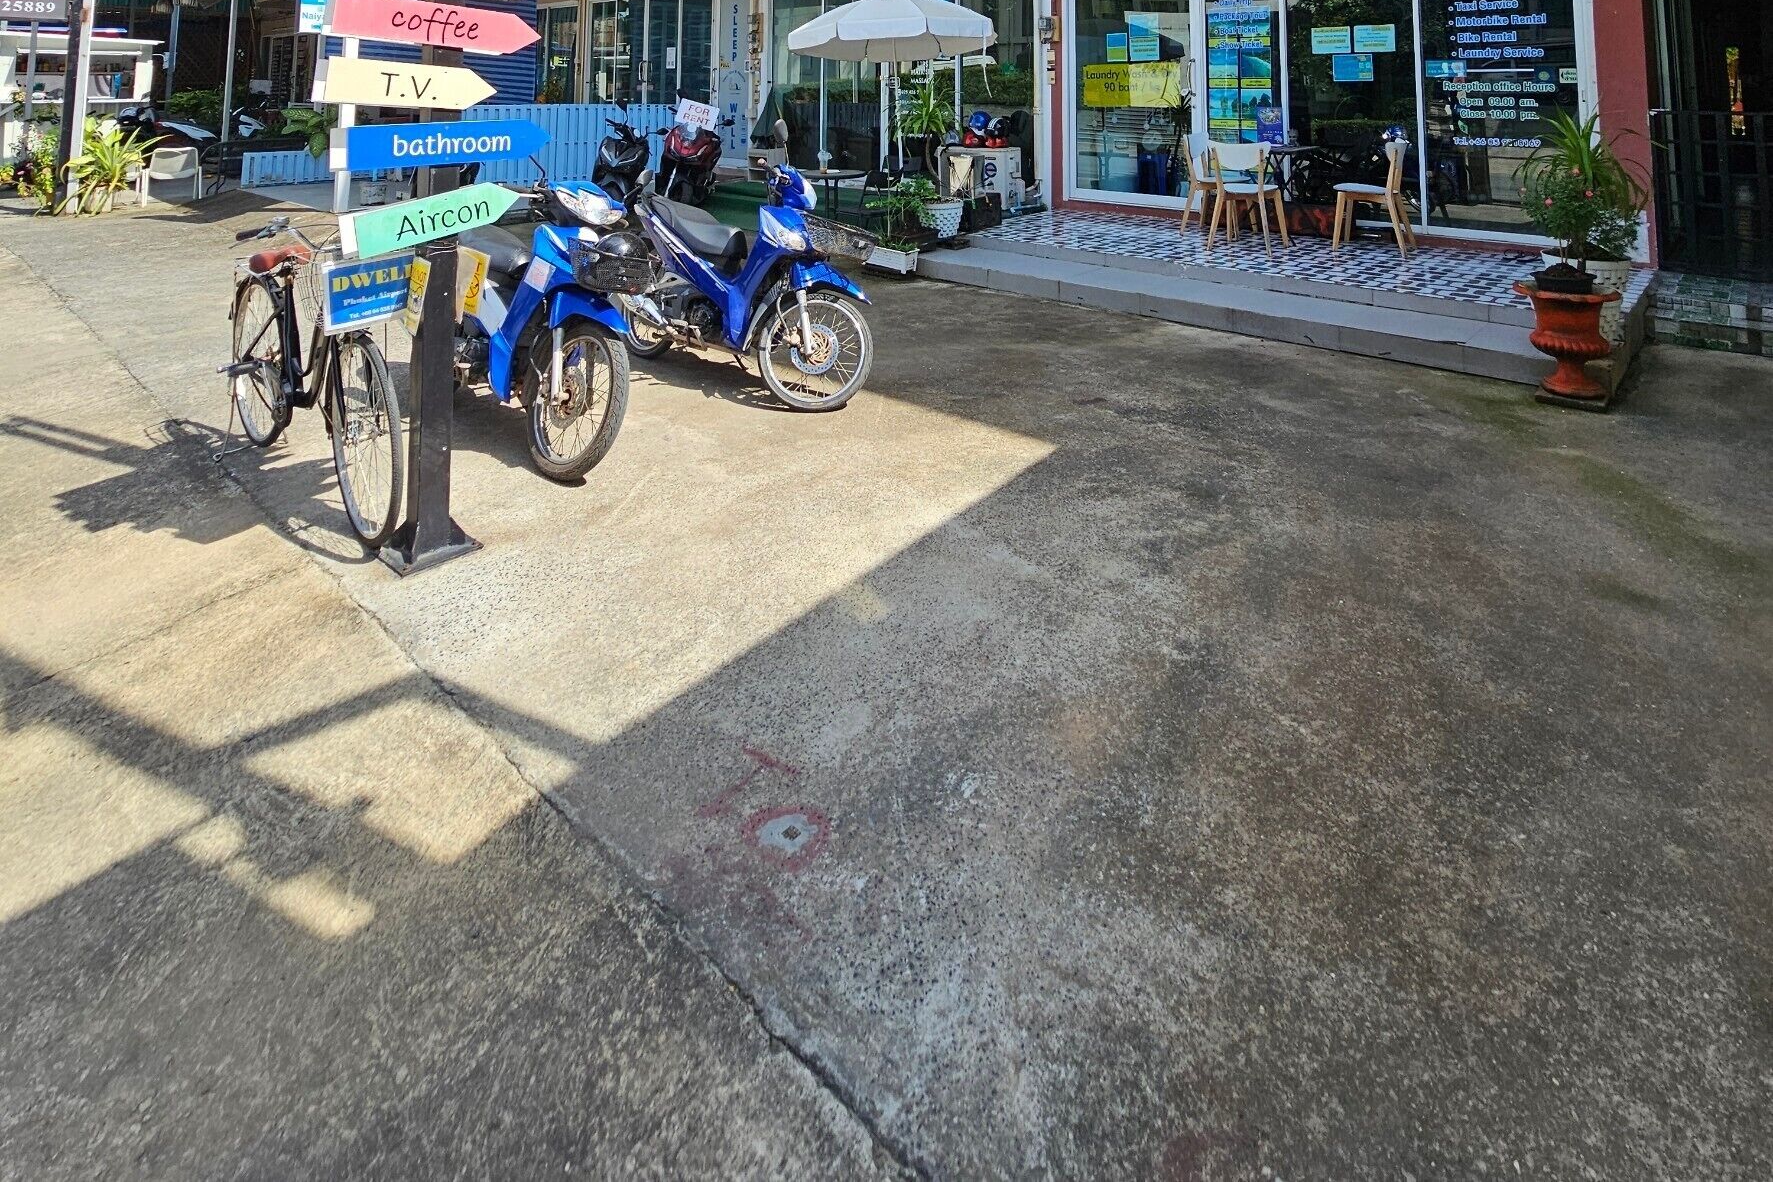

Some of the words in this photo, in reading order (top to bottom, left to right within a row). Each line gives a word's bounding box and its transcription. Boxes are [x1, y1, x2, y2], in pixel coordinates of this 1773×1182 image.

[1, 0, 56, 13] 25889
[1455, 0, 1477, 11] Taxi
[1479, 0, 1518, 10] Service
[302, 12, 325, 22] Naiy
[1456, 15, 1509, 27] Motorbike
[1511, 13, 1547, 25] Rental
[392, 8, 480, 44] coffee
[1220, 26, 1236, 35] Boat
[1238, 25, 1258, 34] Ticket
[1457, 33, 1480, 43] Bike
[1482, 31, 1517, 42] Rental
[1220, 41, 1240, 49] Show
[1241, 39, 1263, 49] Ticket
[1458, 47, 1501, 59] Laundry
[1503, 46, 1544, 58] Service
[1086, 70, 1119, 81] Laundry
[381, 72, 437, 100] T.V.
[1104, 82, 1115, 92] 90
[1443, 80, 1491, 93] Reception
[1493, 81, 1521, 92] office
[1523, 82, 1555, 93] Hours
[1459, 97, 1483, 107] Open
[1488, 97, 1515, 107] 09.00
[1519, 98, 1538, 107] am.
[688, 104, 710, 117] FOR
[1460, 109, 1486, 119] Close
[1489, 109, 1516, 120] 10.00
[683, 112, 711, 126] RENT
[392, 134, 512, 157] bathroom
[396, 197, 490, 242] Aircon
